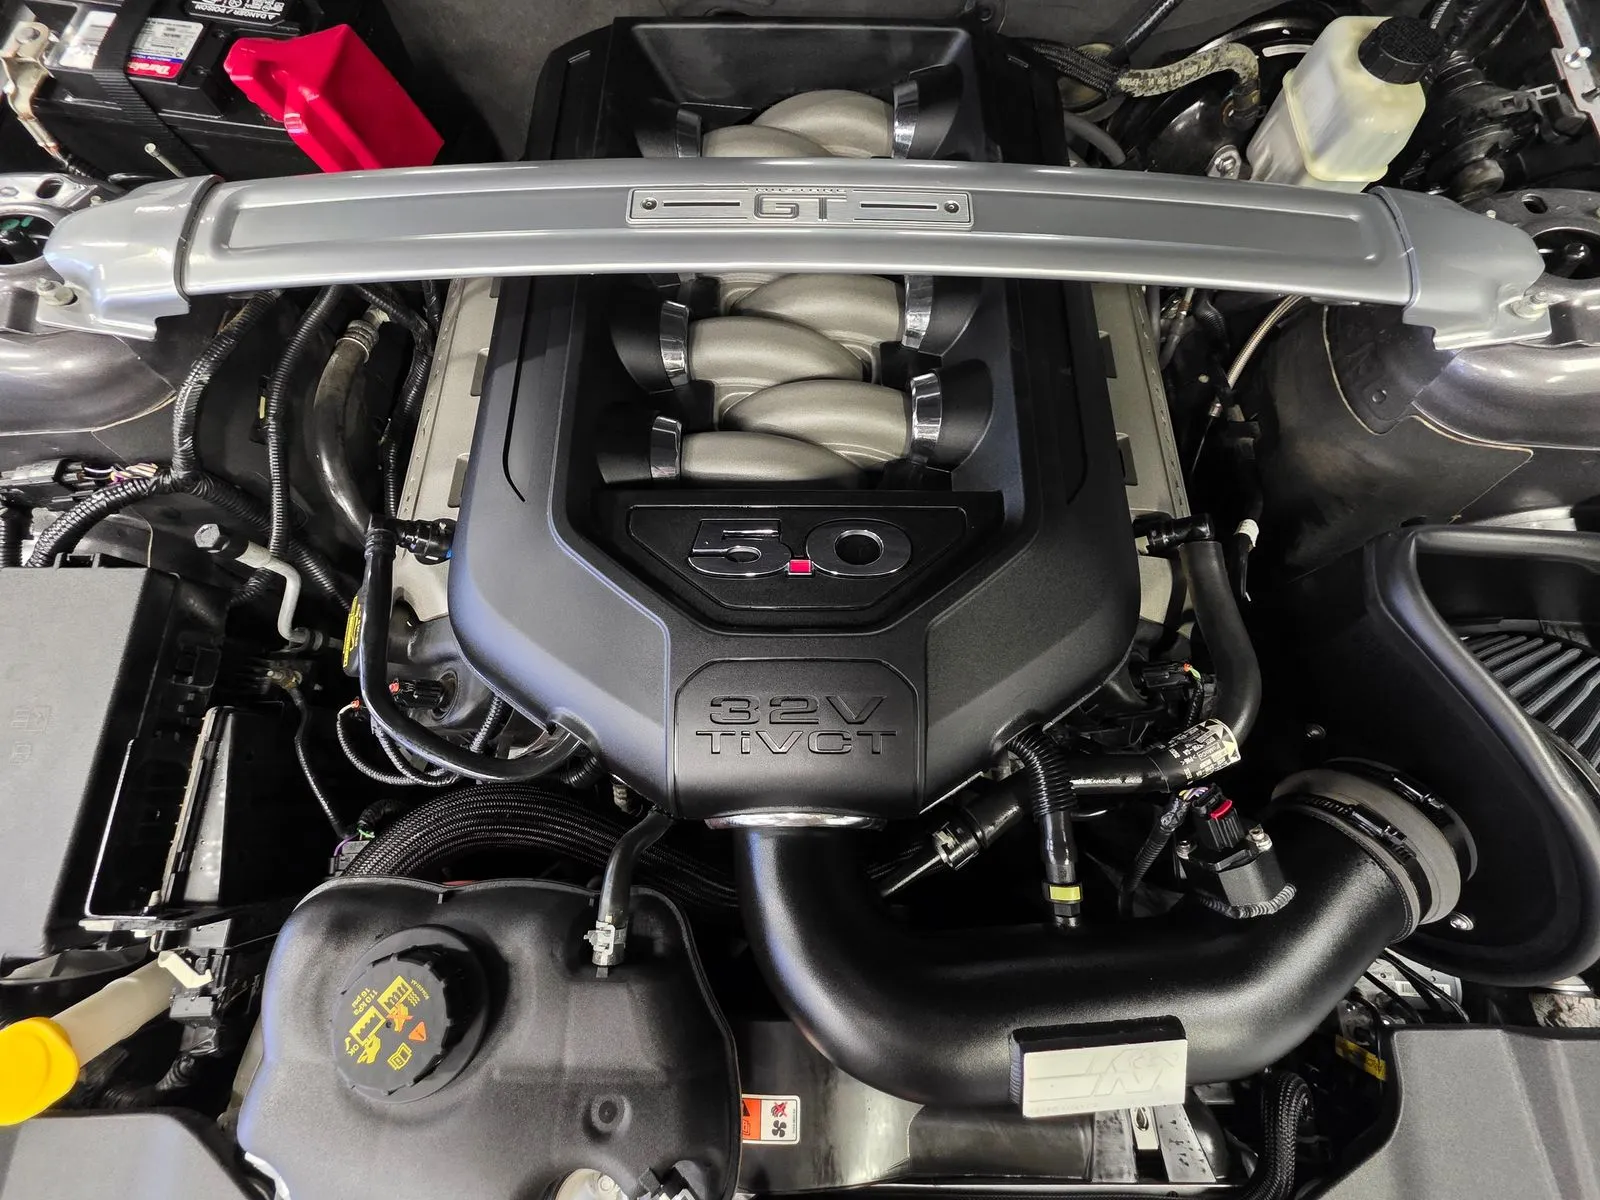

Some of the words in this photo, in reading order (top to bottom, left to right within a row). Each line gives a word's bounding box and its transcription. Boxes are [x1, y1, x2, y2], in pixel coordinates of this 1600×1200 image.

[195, 4, 226, 14] POISON
[233, 10, 267, 20] DANGER
[128, 62, 171, 76] Durala
[753, 194, 848, 222] GT
[688, 517, 913, 578] 5.0
[708, 694, 888, 725] 32V
[695, 730, 898, 755] TiVCT
[365, 990, 378, 1005] 110
[354, 1003, 367, 1016] kPa
[347, 1044, 360, 1057] OK
